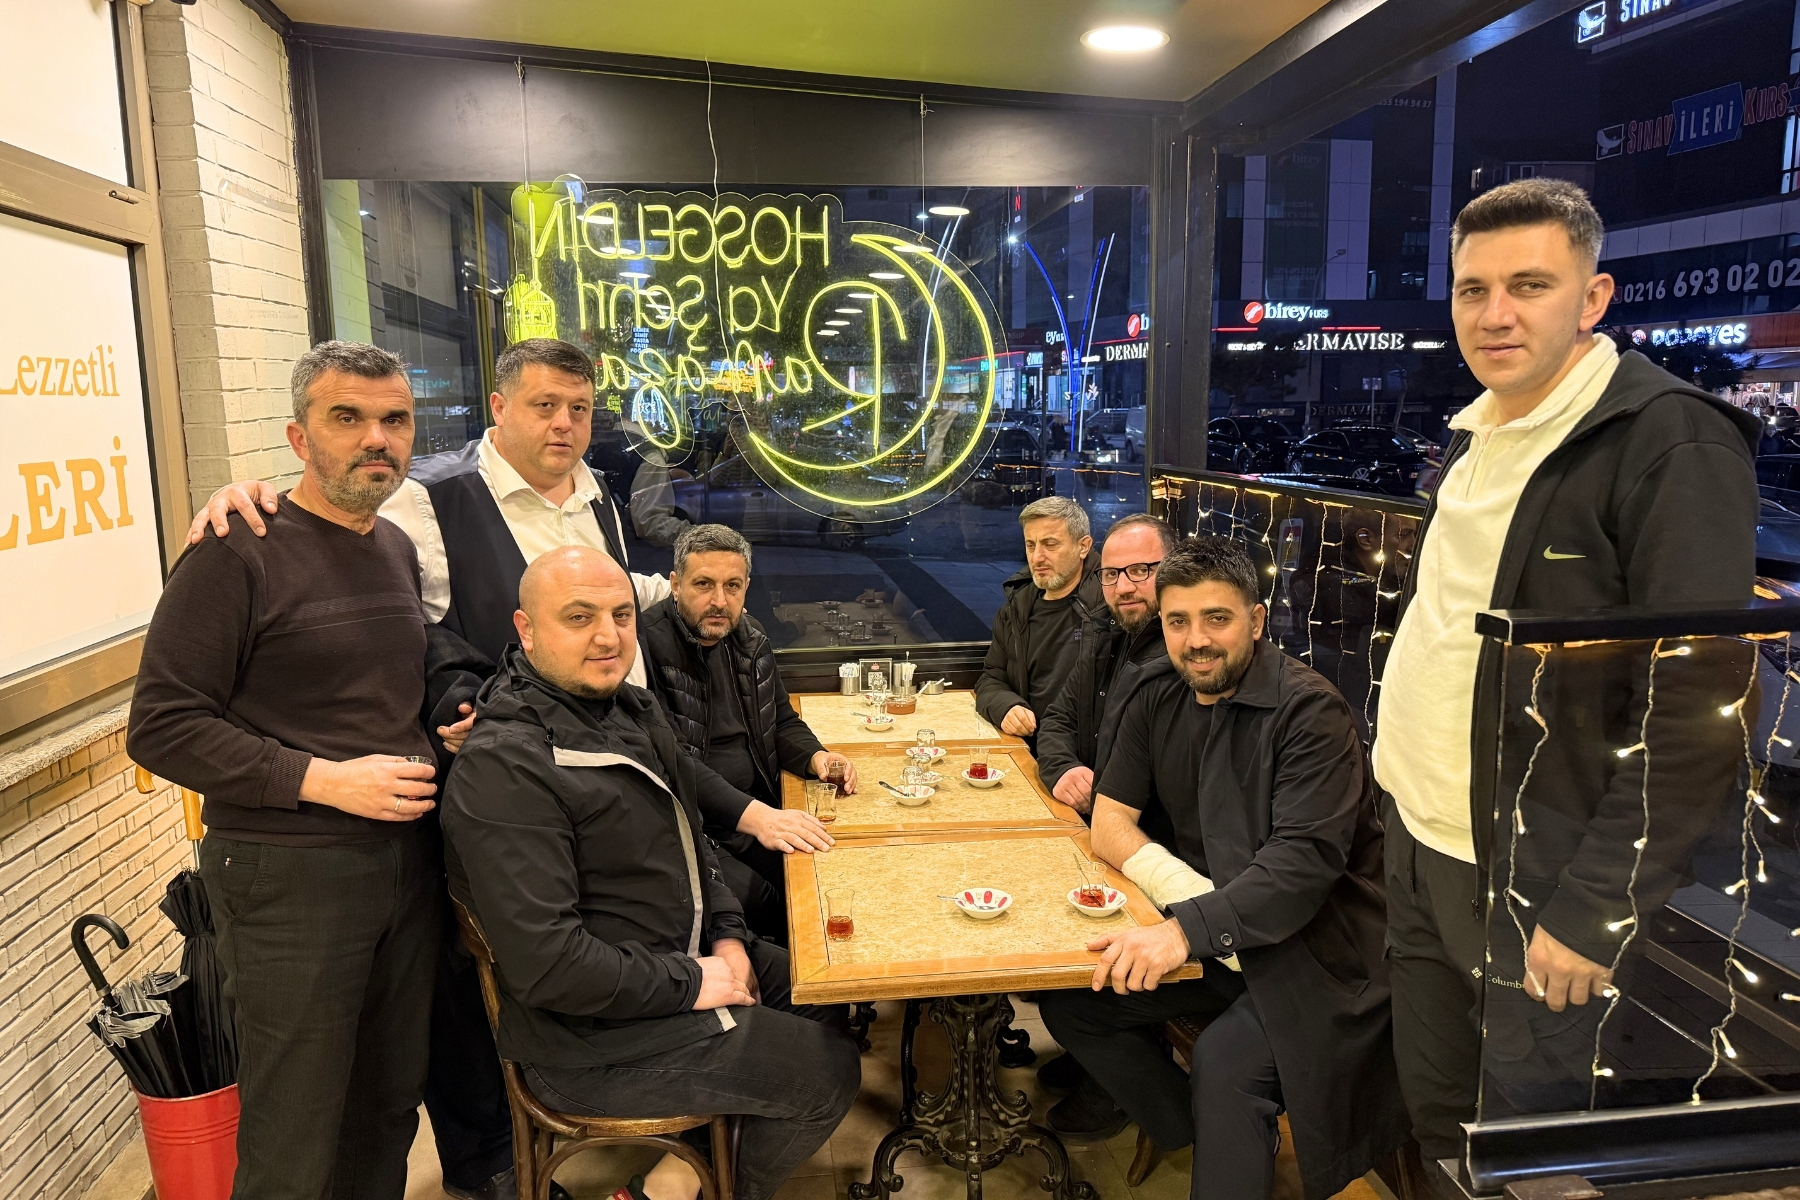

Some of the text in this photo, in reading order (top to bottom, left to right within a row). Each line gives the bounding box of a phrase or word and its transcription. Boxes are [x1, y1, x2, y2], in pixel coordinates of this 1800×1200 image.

[1626, 82, 1788, 154] SINAV İLERİ KURS
[1624, 257, 1800, 303] 0216 693 02 02
[1264, 302, 1310, 321] birey
